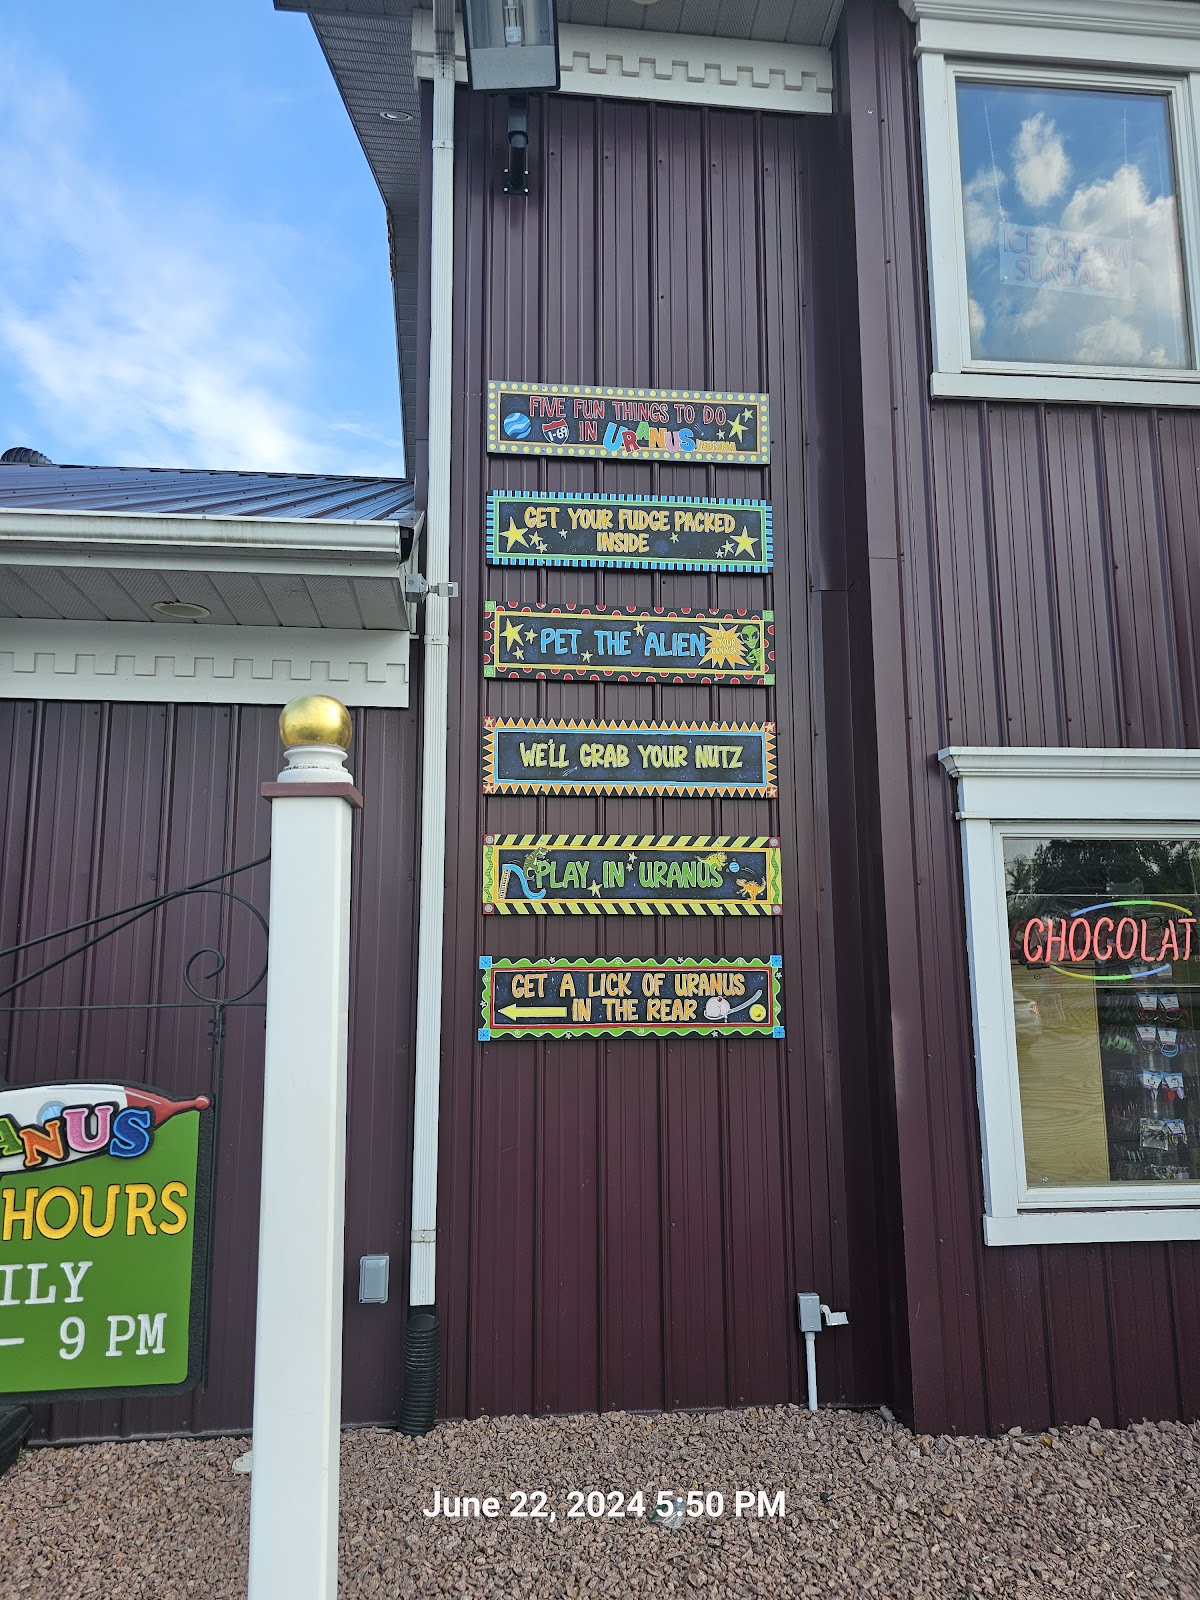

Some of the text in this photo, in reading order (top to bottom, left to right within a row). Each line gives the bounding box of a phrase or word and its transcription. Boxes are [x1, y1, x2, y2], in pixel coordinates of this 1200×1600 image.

[1003, 225, 1129, 270] ICE CREAM
[1015, 256, 1119, 293] SUNDAES
[529, 396, 727, 426] FIVE FUN THINGS TO DO
[547, 426, 568, 441] I-69
[579, 421, 696, 453] IN URANUS
[524, 506, 736, 533] GET YOUR FUDGE PACKED
[596, 532, 650, 552] INSIDE
[540, 628, 706, 657] PET THE ALIEN
[718, 639, 736, 647] YOUR
[519, 739, 743, 769] WE'LL GRAB YOUR NUTZ
[536, 860, 723, 889] PLAY IN URANUS
[1023, 917, 1197, 962] CHOCOLAT
[511, 972, 746, 998] GET A LICK OF URANUS
[572, 998, 697, 1022] IN THE REAR
[1, 1181, 189, 1241] HOURS
[59, 1316, 86, 1360] 9
[105, 1312, 168, 1357] PM
